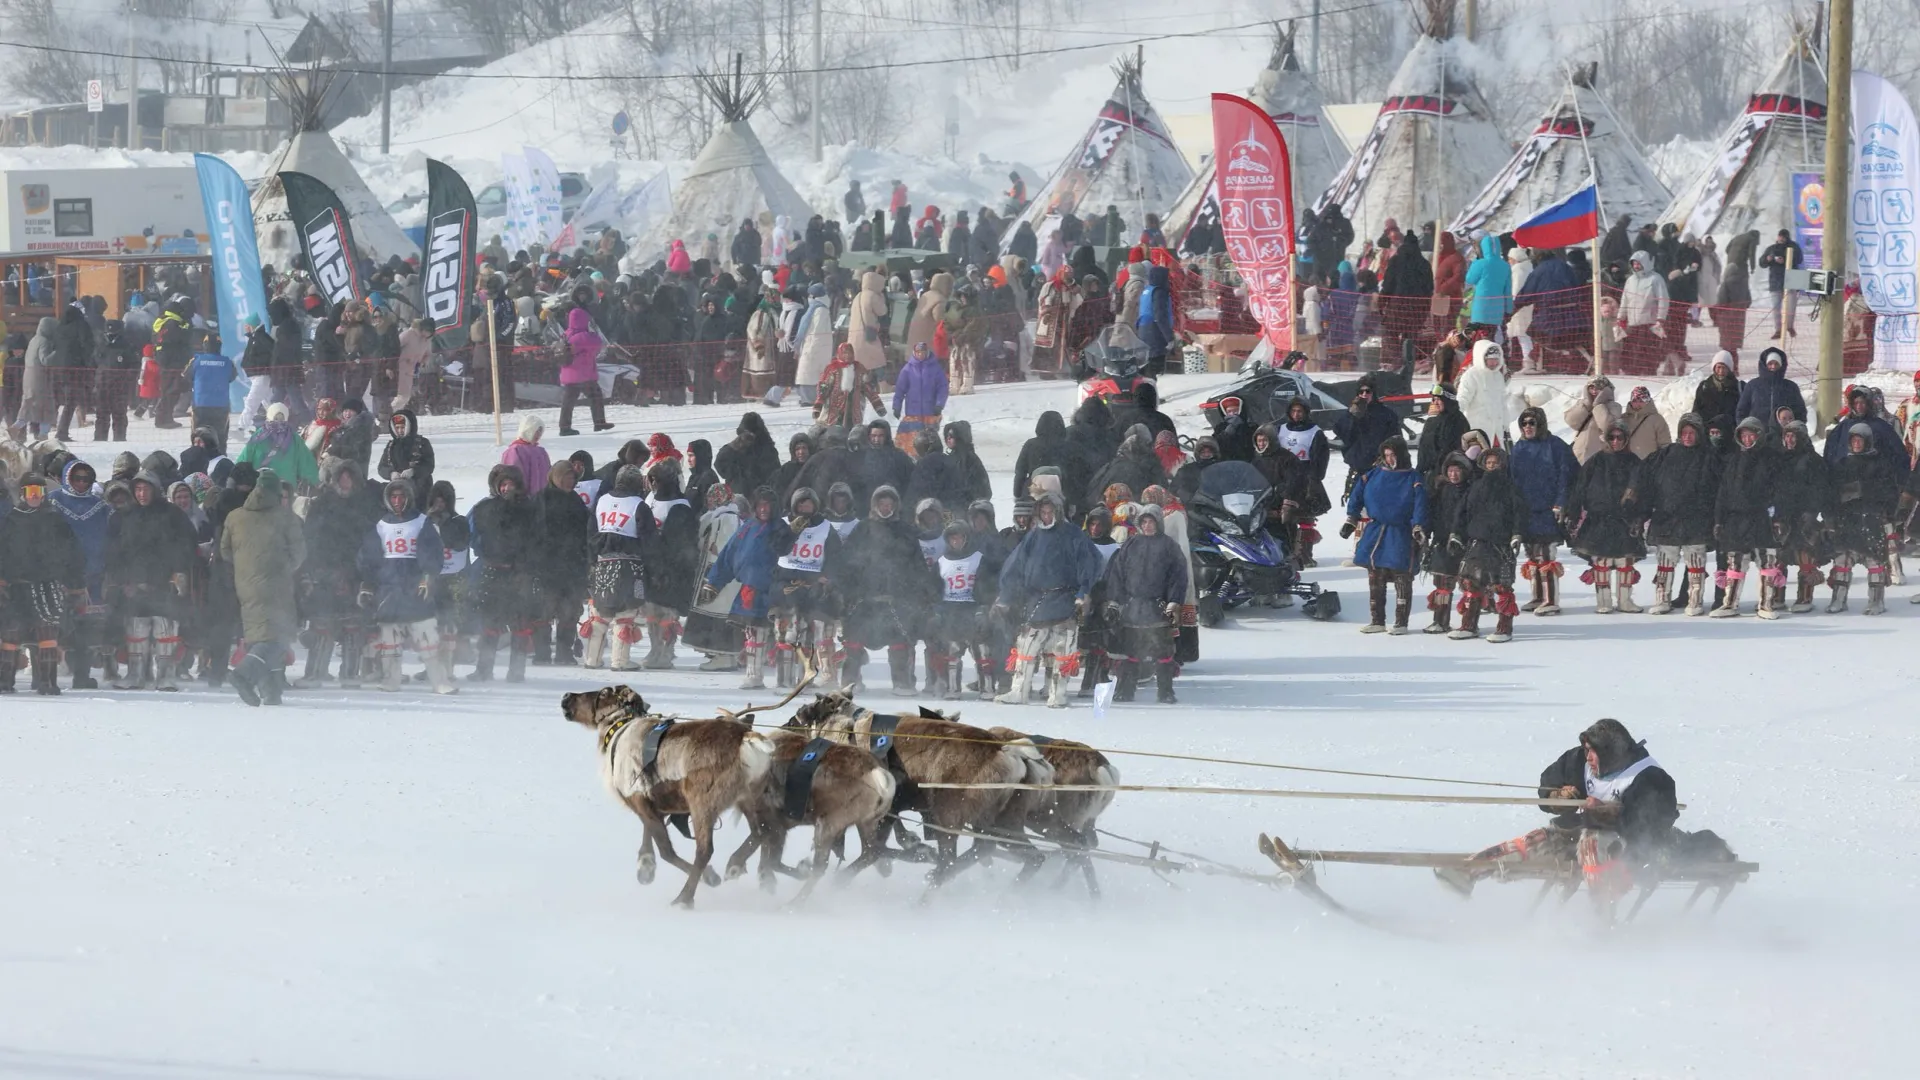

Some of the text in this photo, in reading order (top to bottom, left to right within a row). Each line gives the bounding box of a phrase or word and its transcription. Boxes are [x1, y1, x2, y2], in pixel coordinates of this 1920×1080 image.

[80, 240, 109, 249] СЛУЖБА
[600, 512, 630, 528] 147
[792, 544, 822, 558] 160
